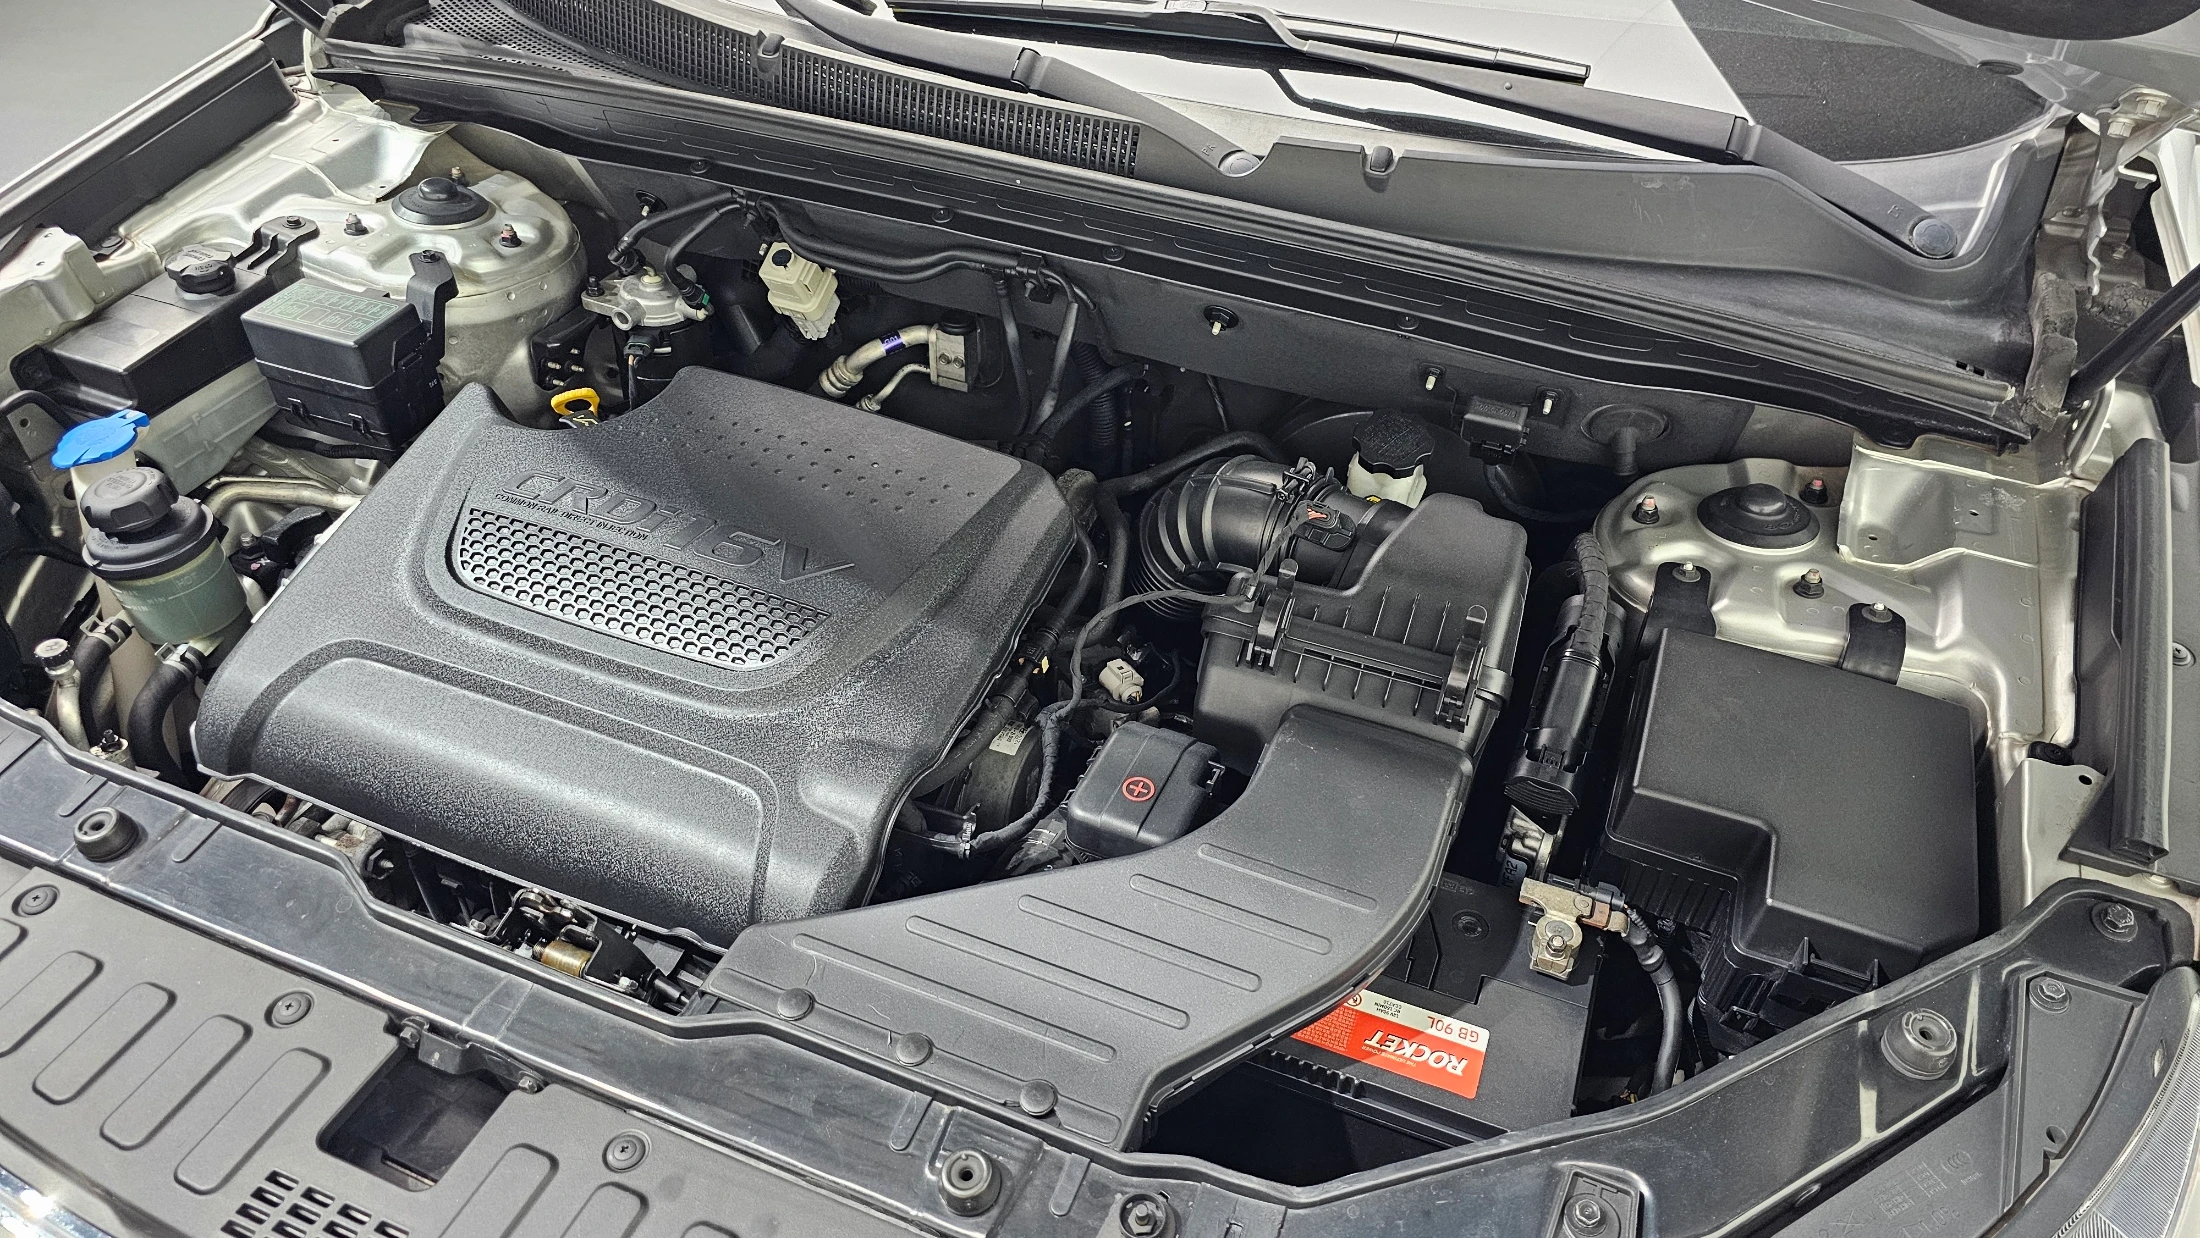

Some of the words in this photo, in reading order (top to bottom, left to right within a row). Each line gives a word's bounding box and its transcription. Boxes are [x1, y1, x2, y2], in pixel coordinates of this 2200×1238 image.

[560, 511, 597, 525] DIRECT
[596, 521, 650, 541] INJECTION
[662, 513, 855, 584] 16V
[1427, 1015, 1454, 1035] 90L
[1458, 1026, 1479, 1043] GB
[1363, 1029, 1469, 1077] ROCKET
